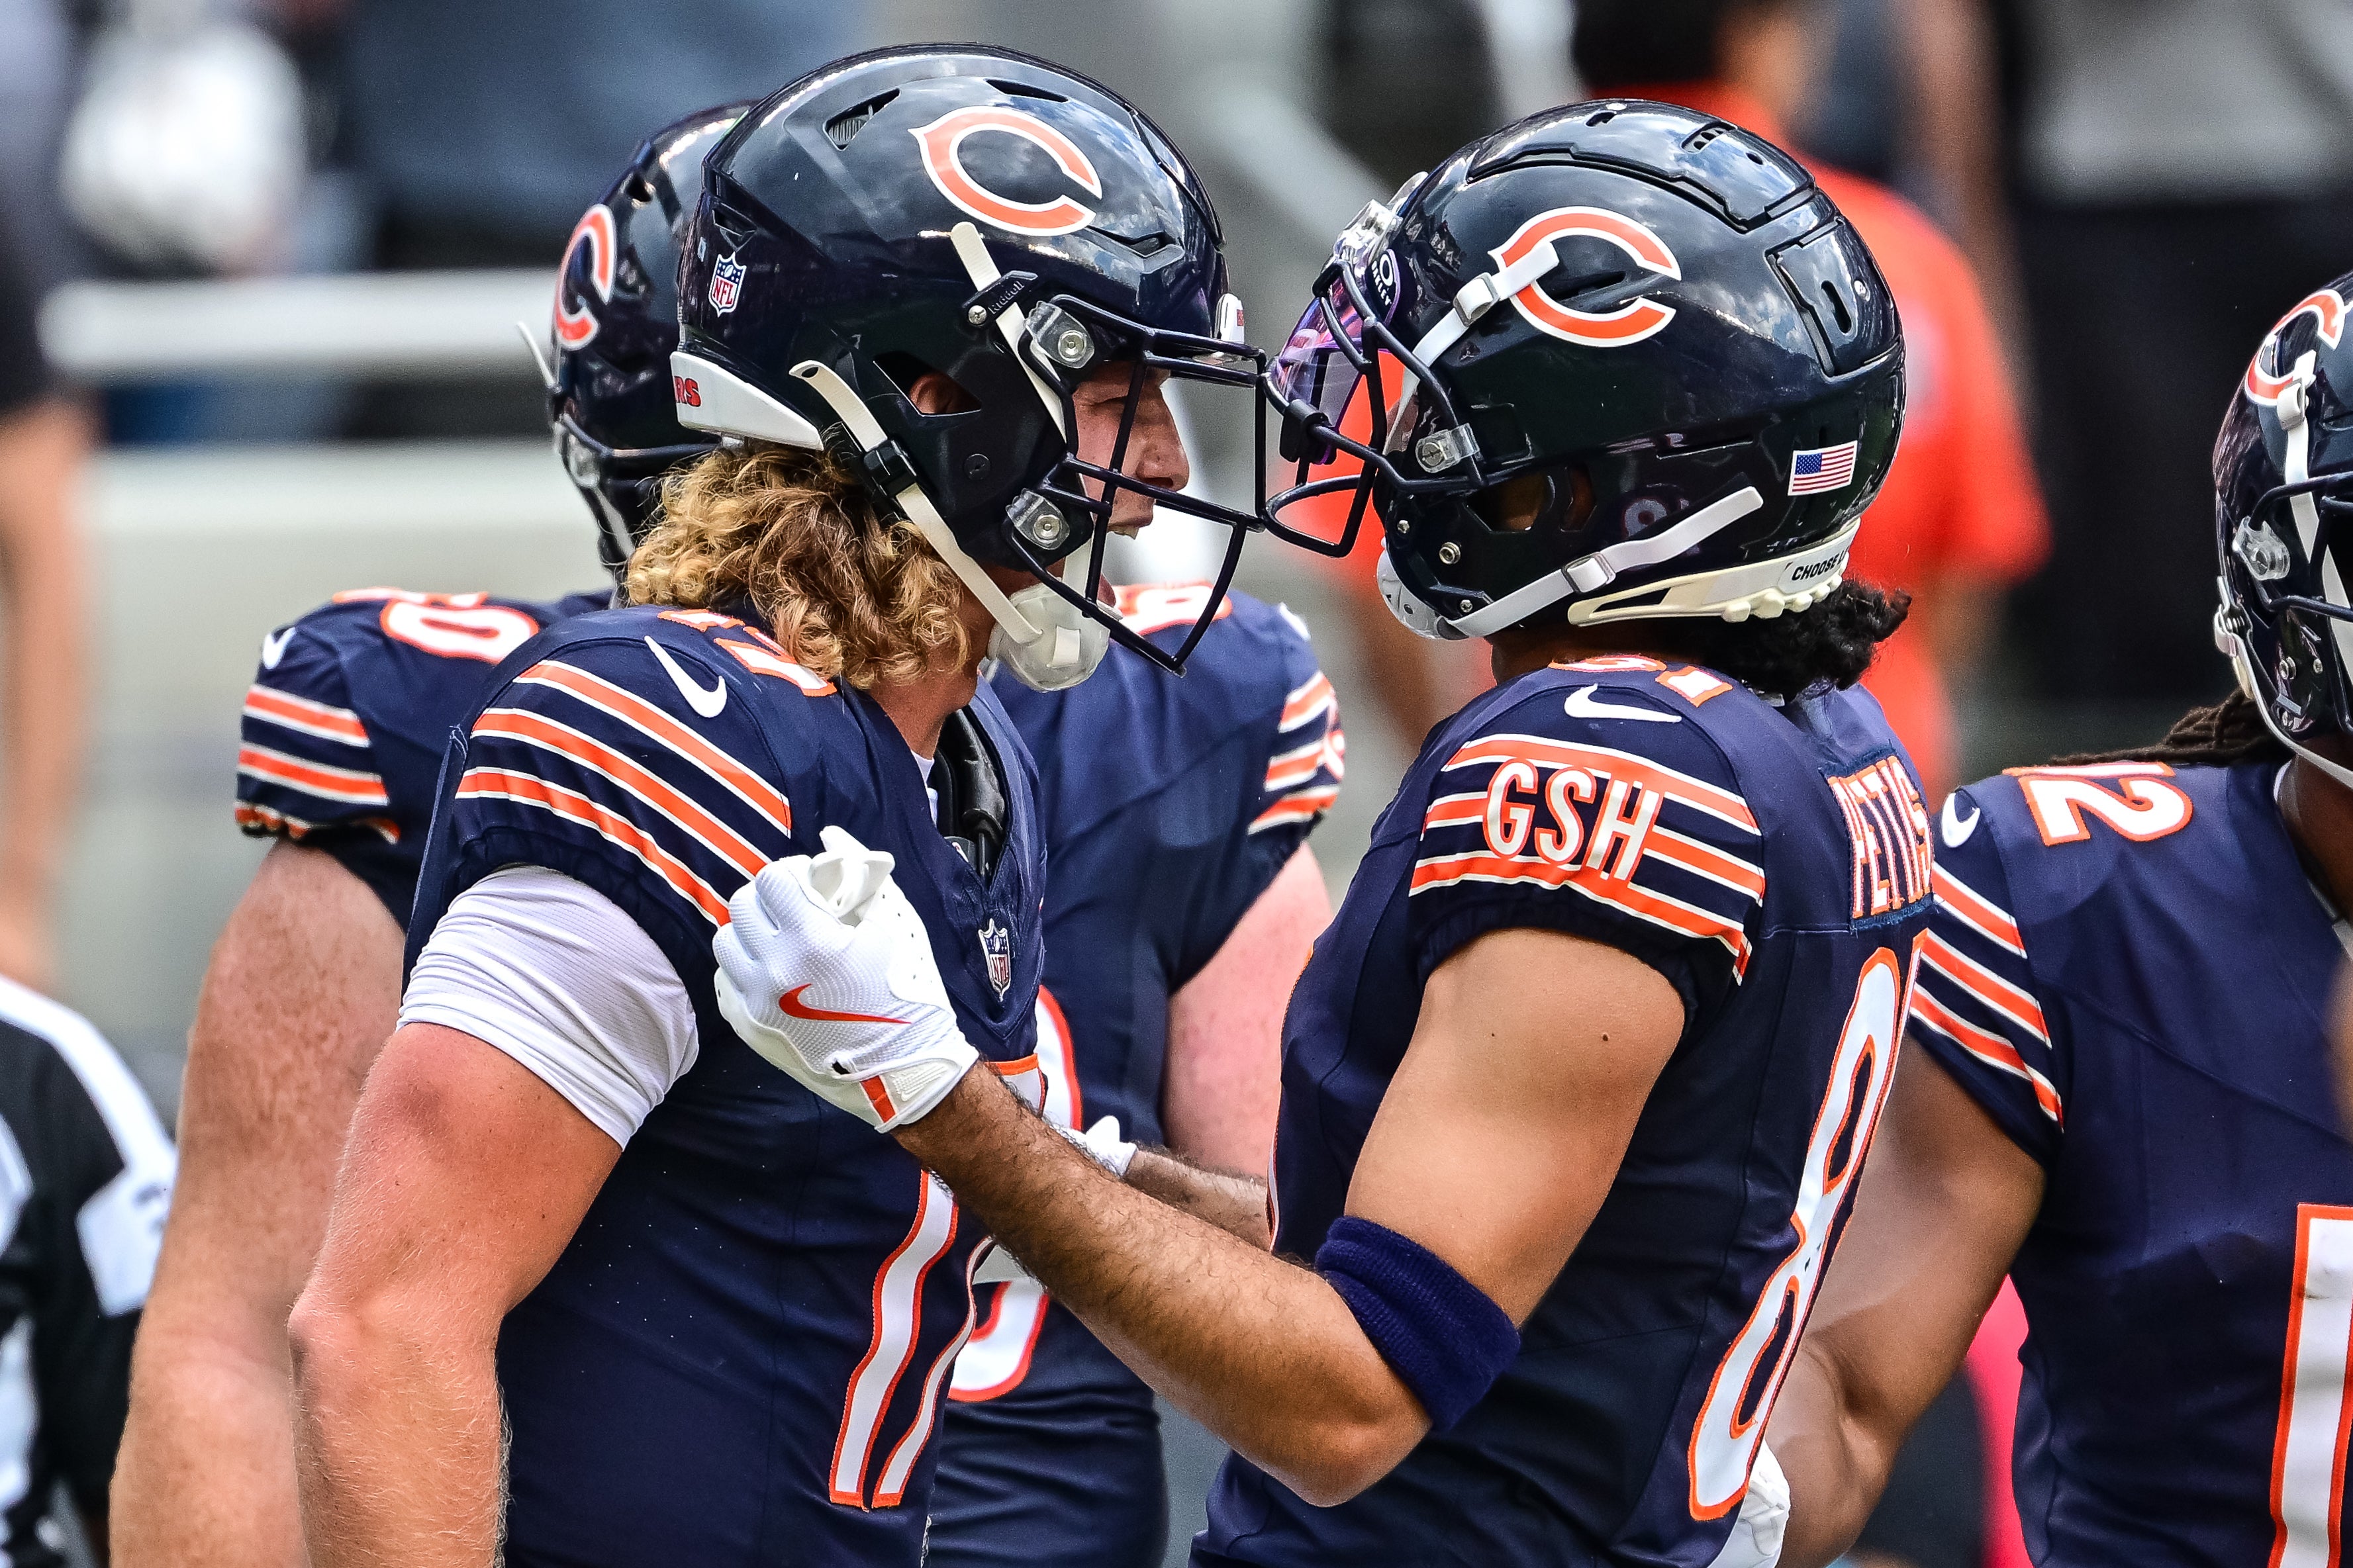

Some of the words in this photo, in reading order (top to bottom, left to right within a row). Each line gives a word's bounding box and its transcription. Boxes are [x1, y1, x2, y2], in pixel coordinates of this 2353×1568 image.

[907, 105, 1102, 236] C
[1371, 259, 1392, 306] OAKLEY
[1488, 205, 1682, 347] C
[1791, 553, 1841, 581] CHOOSE
[1481, 757, 1667, 881] GSH
[1827, 755, 1935, 919] PETTIS
[2001, 761, 2193, 847] 12
